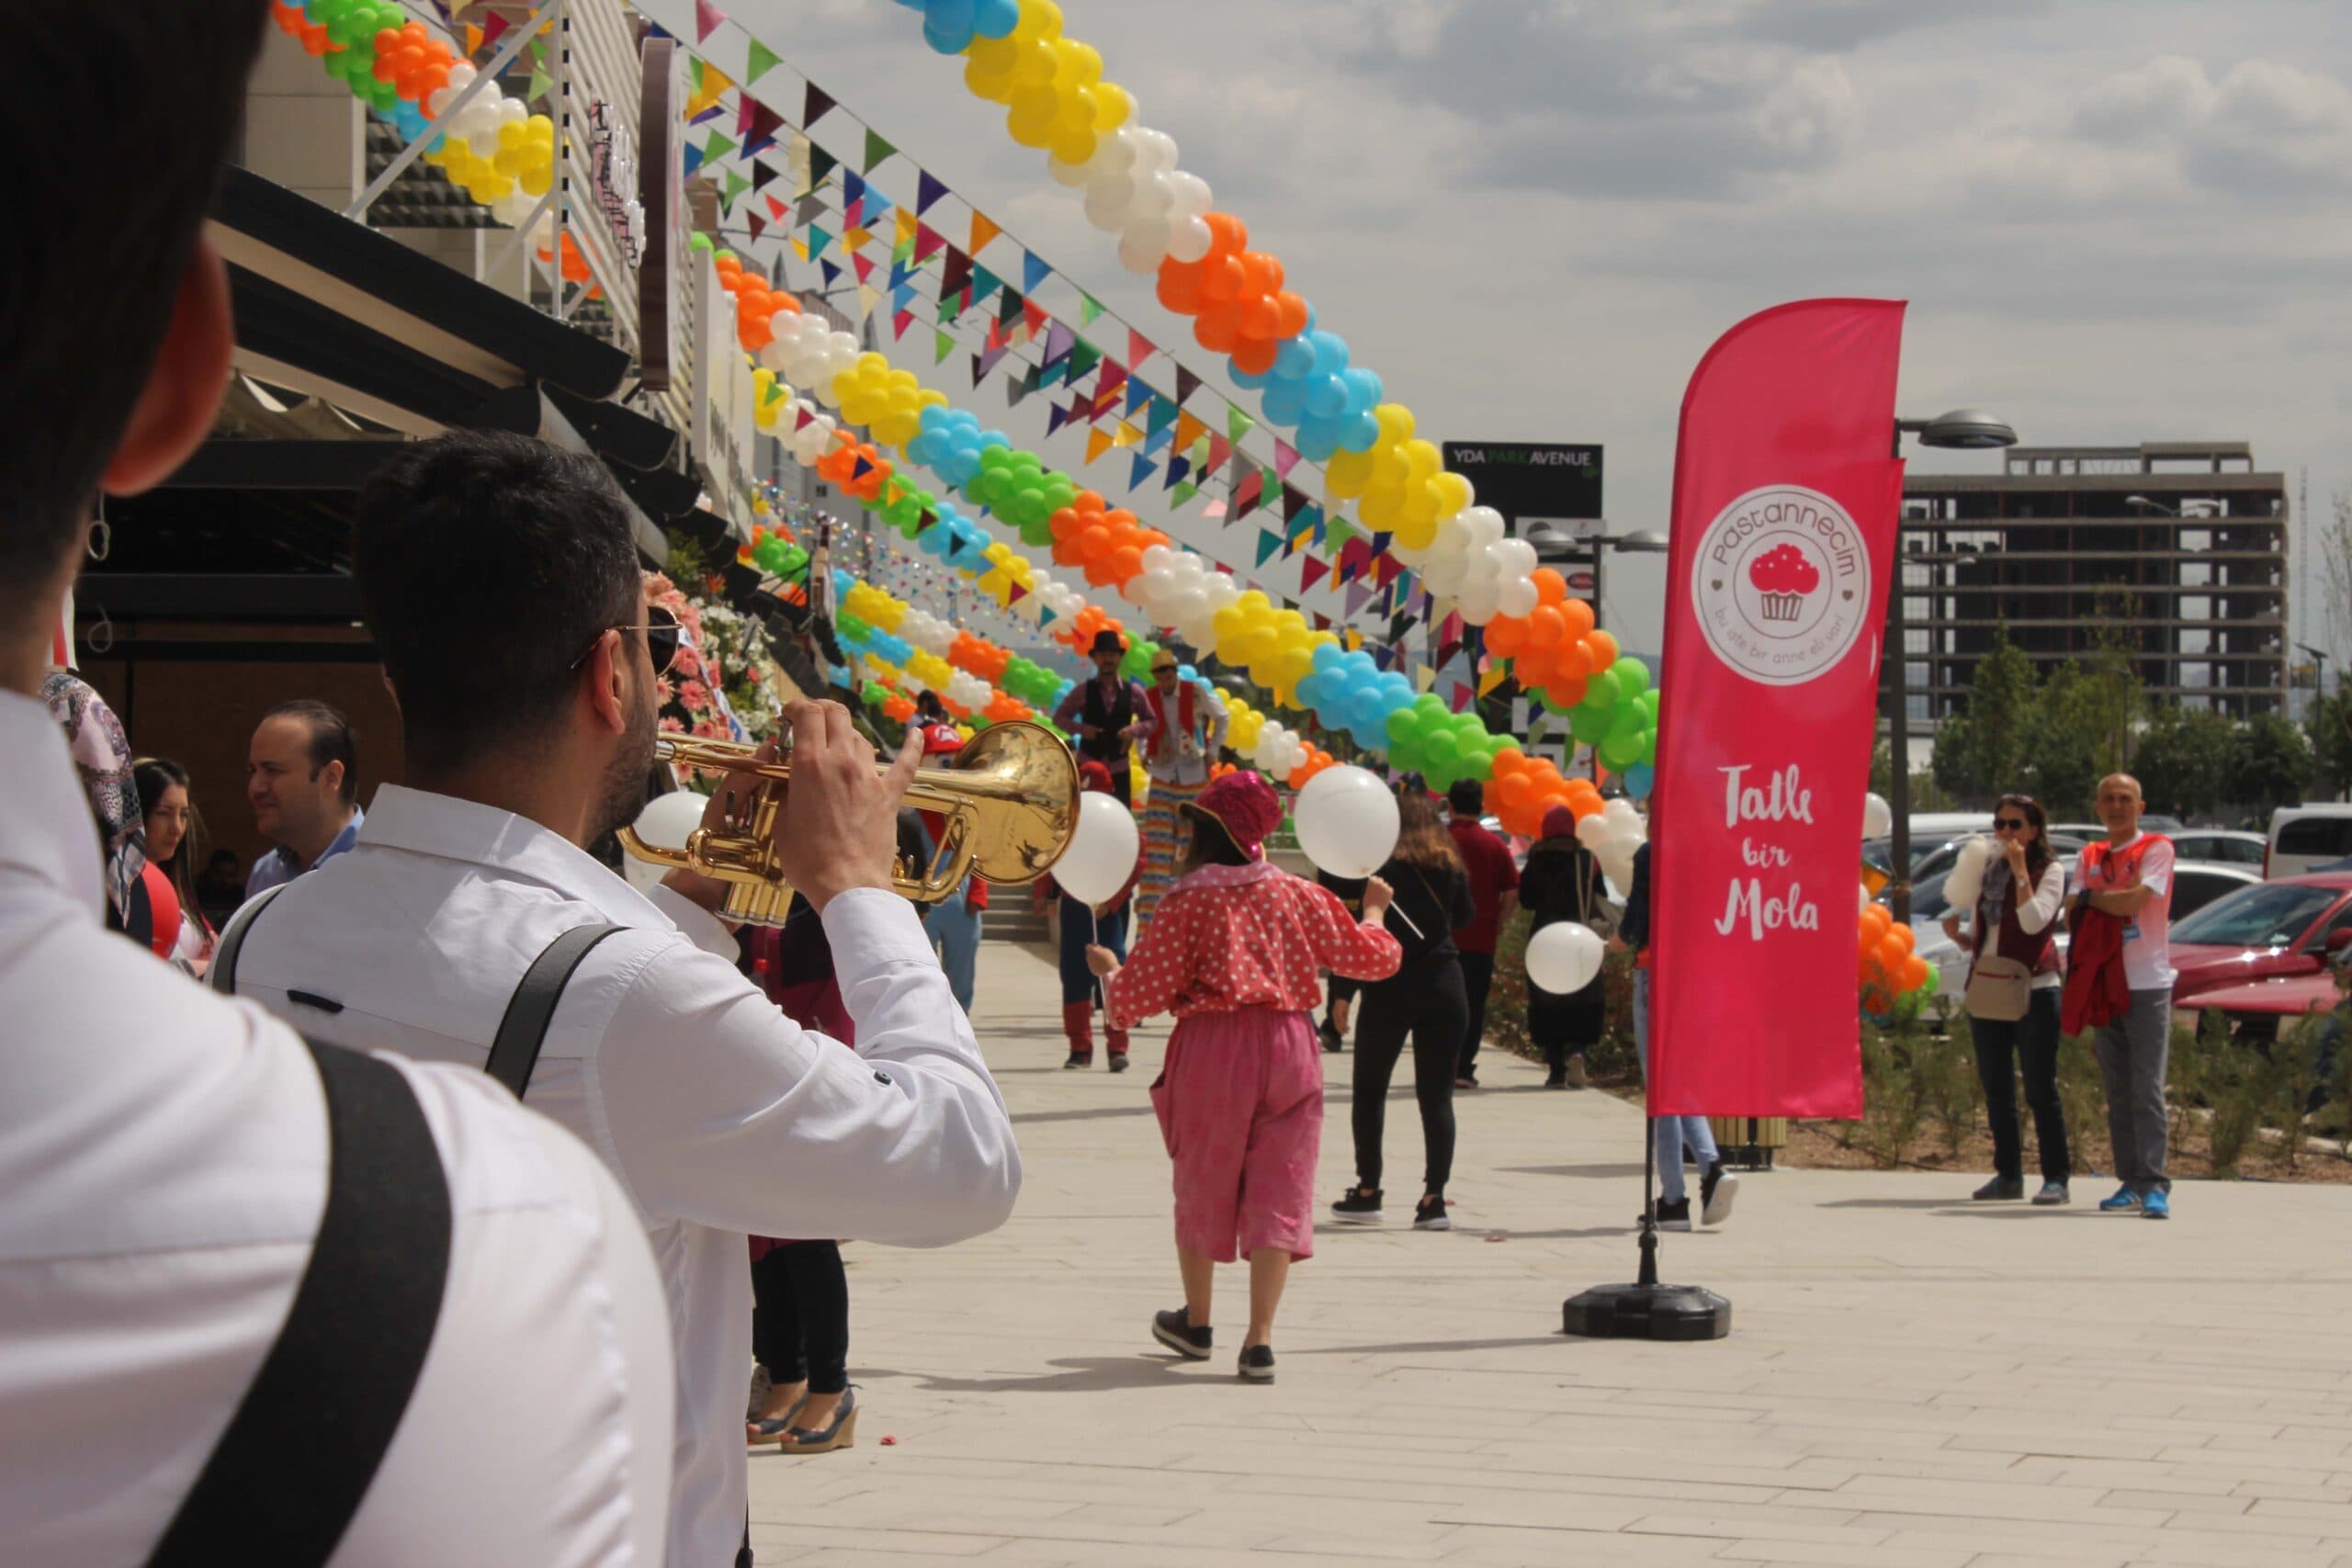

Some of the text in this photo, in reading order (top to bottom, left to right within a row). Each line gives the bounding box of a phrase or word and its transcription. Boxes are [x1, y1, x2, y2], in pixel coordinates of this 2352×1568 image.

[1453, 448, 1486, 464] YDA
[1529, 451, 1591, 466] AVENUE
[1742, 837, 1792, 868] bir
[1713, 877, 1819, 942] Mola
